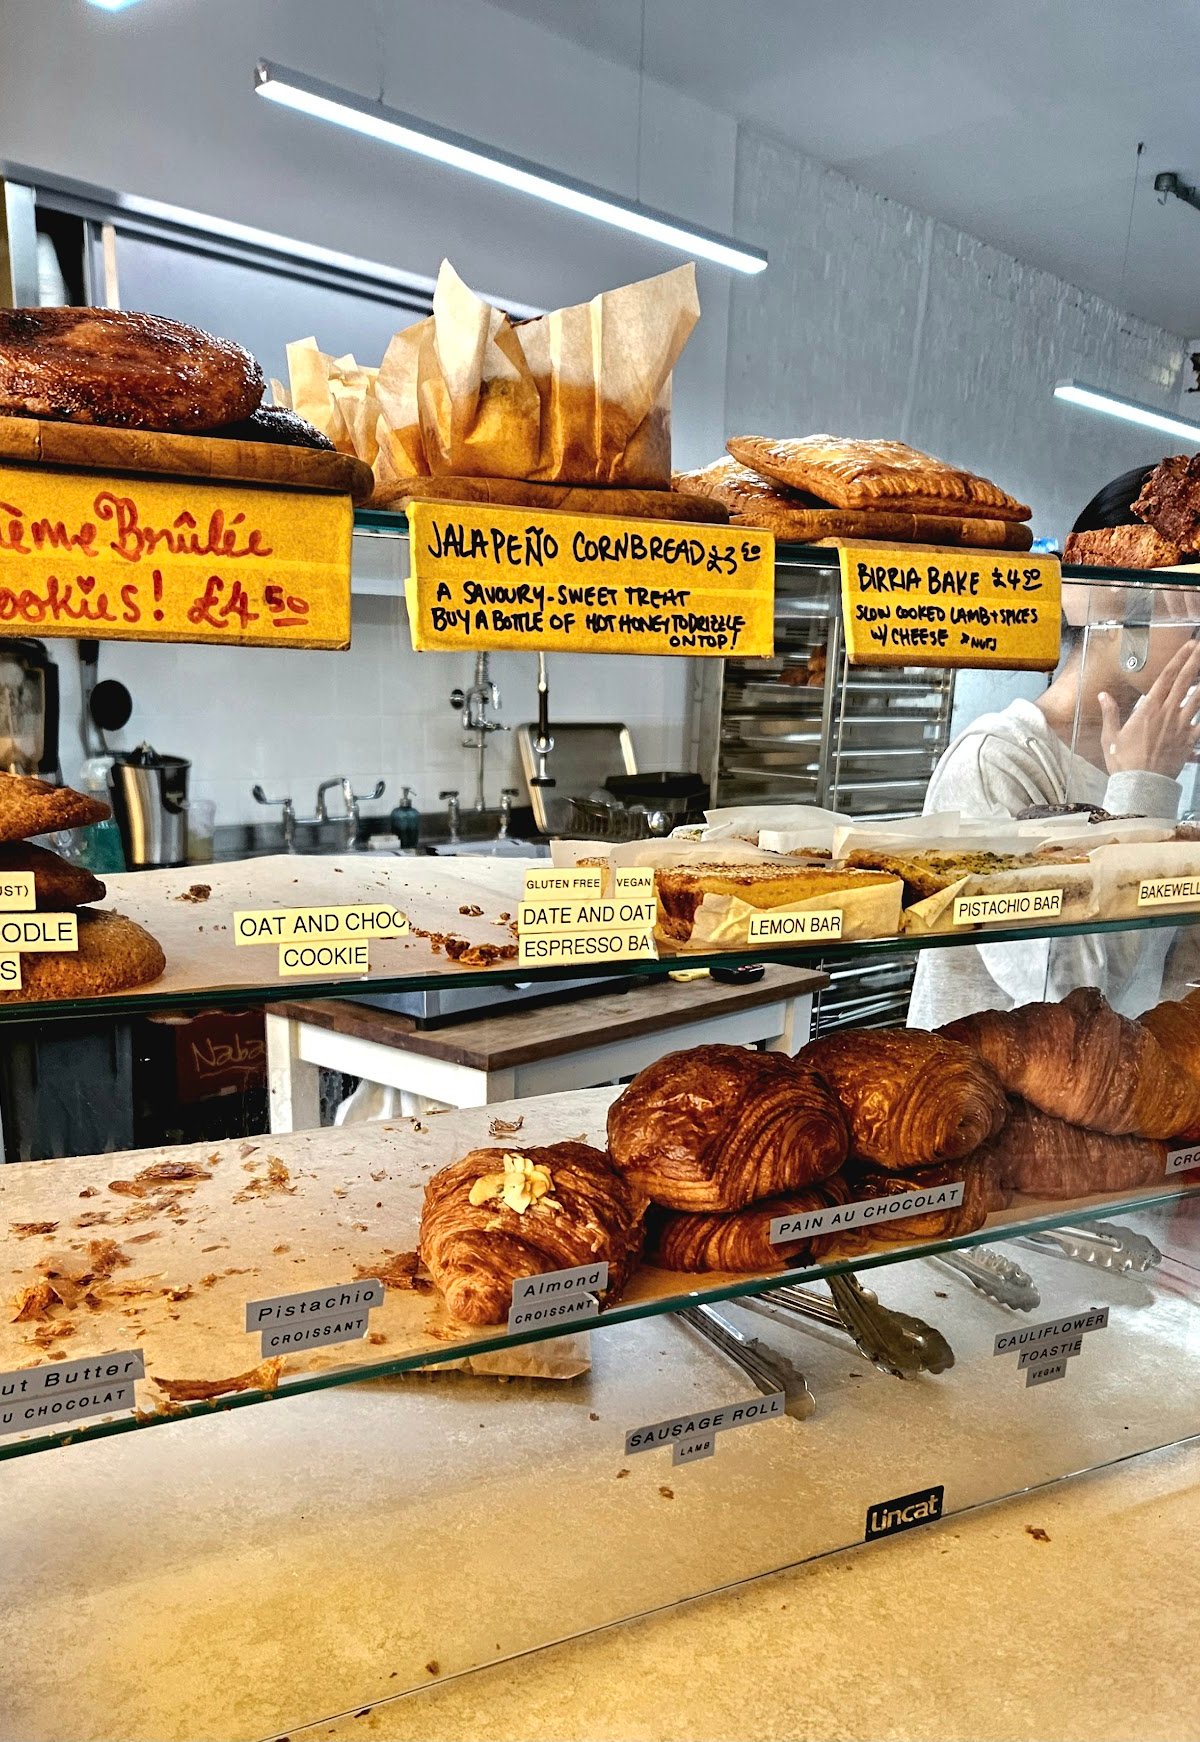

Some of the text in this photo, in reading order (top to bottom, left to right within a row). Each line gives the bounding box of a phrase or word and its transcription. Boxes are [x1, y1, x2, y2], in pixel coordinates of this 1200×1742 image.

[94, 491, 273, 562] Brûlée
[428, 521, 558, 566] JALAPEÑO
[572, 531, 705, 566] CORNBREAD
[856, 562, 922, 593] BIRRIA
[927, 566, 980, 595] BAKE
[437, 582, 452, 602] A
[624, 586, 690, 608] TREAT
[431, 607, 470, 635] BUY
[475, 609, 488, 630] A
[492, 609, 544, 632] BOTTLE
[550, 613, 576, 634] OF
[585, 612, 617, 634] HOT
[855, 604, 891, 622] SLOW
[895, 605, 946, 622] COOKED
[891, 627, 950, 647] CHEESE
[0, 885, 29, 898] ST)
[526, 879, 600, 890] GLUTEN FREE
[616, 878, 651, 887] VEGAN
[1140, 882, 1200, 900] BAKEWELL
[523, 904, 656, 925] DATE AND OAT
[959, 895, 1060, 918] PISTACHIO BAR
[2, 922, 73, 943] ODLE
[240, 911, 406, 936] OAT AND CHOC
[750, 916, 841, 935] LEMON BAR
[284, 946, 367, 967] COOKIE
[525, 936, 623, 957] ESPRESSO
[0, 961, 17, 980] S
[779, 1189, 958, 1235] PAIN AU CHOCOLAT
[523, 1271, 600, 1298] Almond
[258, 1290, 374, 1322] Pistachio
[515, 1299, 592, 1324] CROISSANT
[270, 1319, 364, 1347] CROISSANT
[997, 1314, 1105, 1350] CAULIFLOWER
[1021, 1340, 1083, 1363] TOASTIE
[1, 1361, 134, 1396] ut Butter
[1032, 1365, 1062, 1379] VEGAN
[24, 1389, 126, 1419] CHOCOLAT
[630, 1401, 780, 1447] SAUSAGE ROLL
[680, 1441, 711, 1456] LAMB
